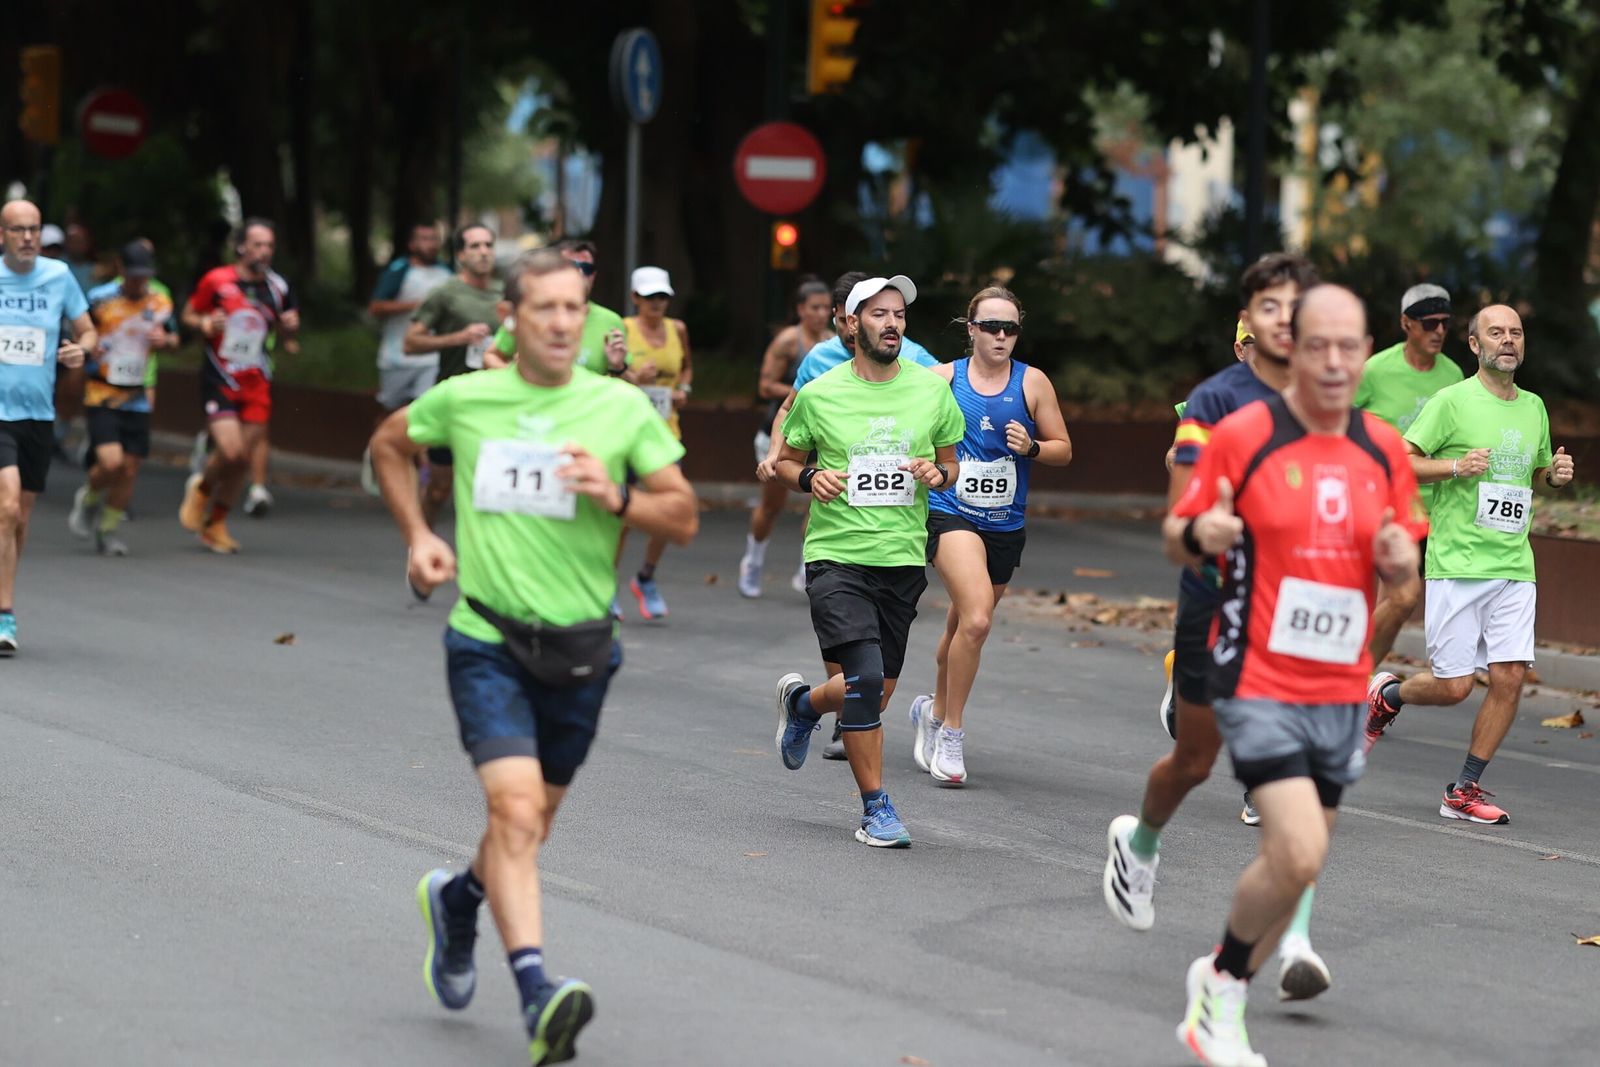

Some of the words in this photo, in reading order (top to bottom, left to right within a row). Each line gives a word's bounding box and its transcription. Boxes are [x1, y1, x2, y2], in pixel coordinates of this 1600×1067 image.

[0, 293, 48, 312] erja
[2, 340, 36, 353] 742
[504, 467, 541, 491] 11
[857, 473, 905, 491] 262
[965, 477, 1008, 494] 369
[958, 505, 985, 518] mayoral
[1487, 498, 1524, 519] 786
[1290, 608, 1351, 637] 807
